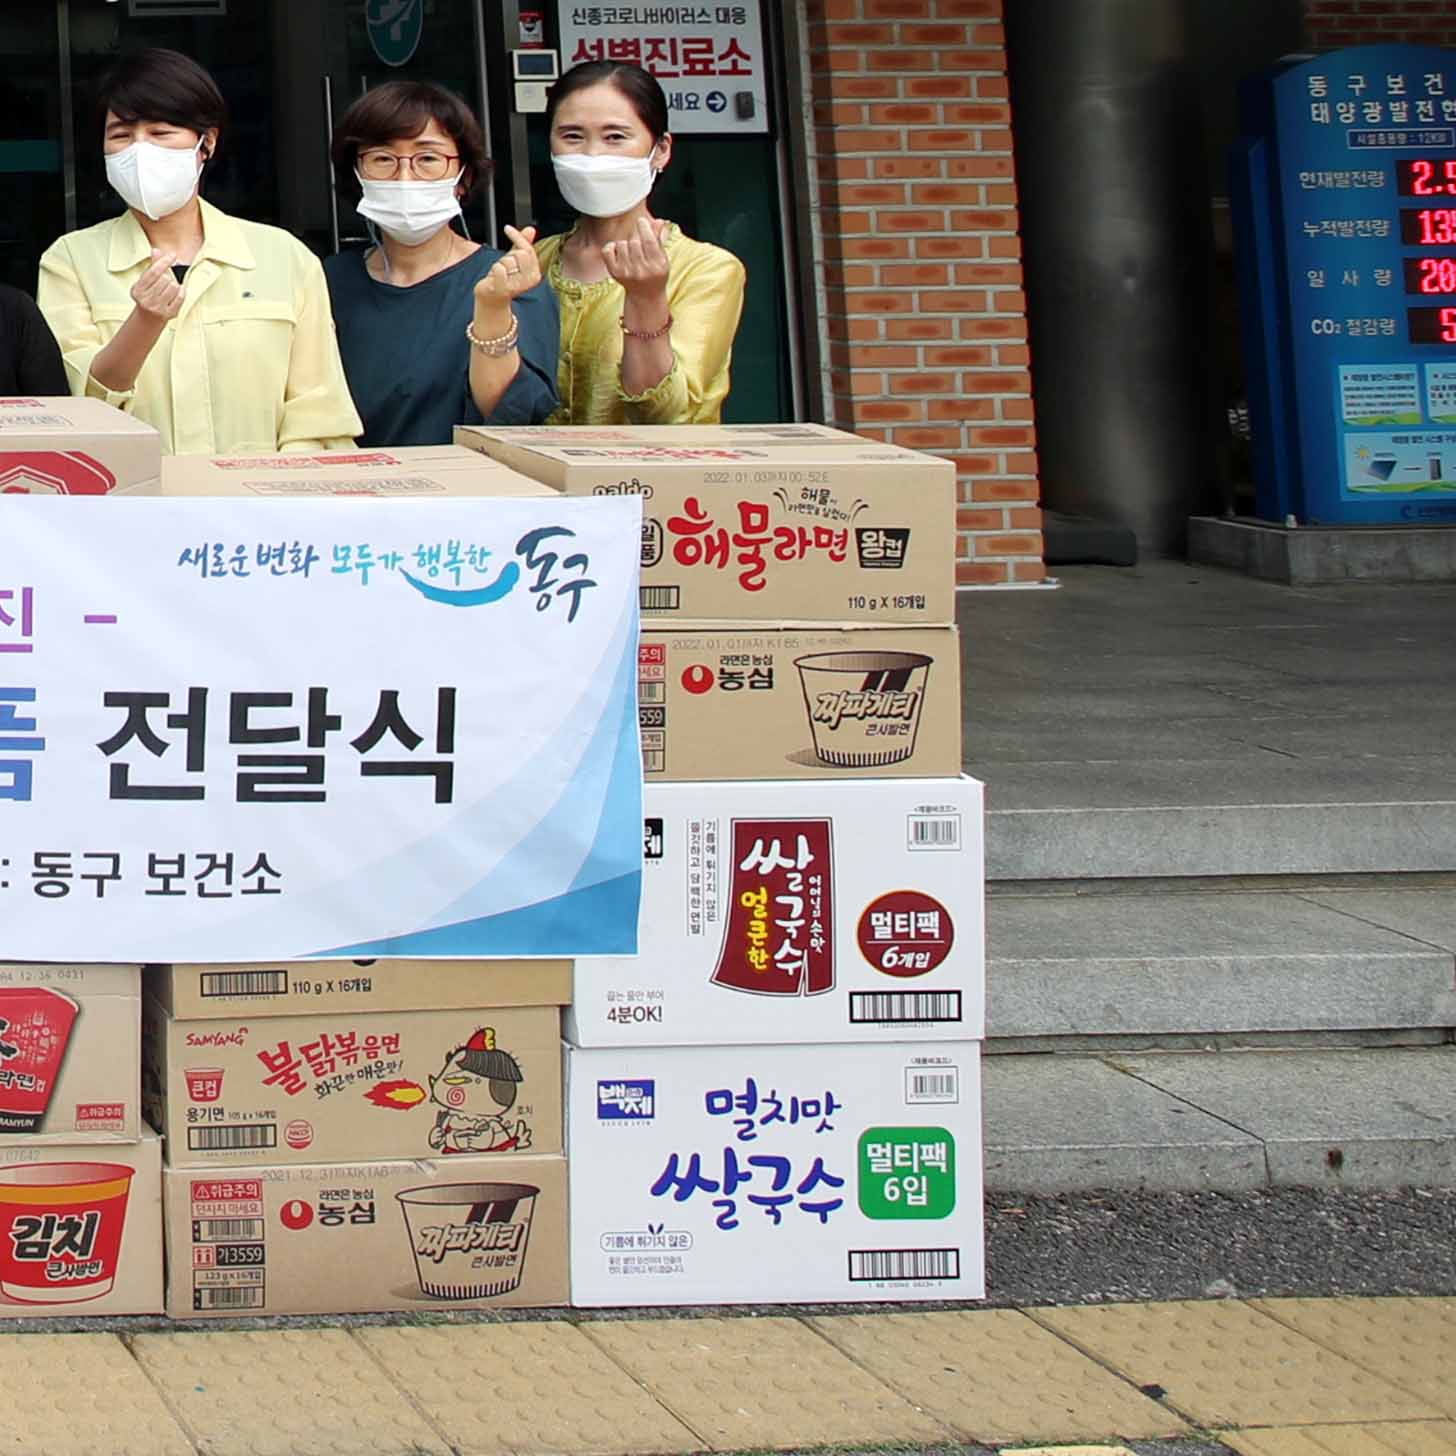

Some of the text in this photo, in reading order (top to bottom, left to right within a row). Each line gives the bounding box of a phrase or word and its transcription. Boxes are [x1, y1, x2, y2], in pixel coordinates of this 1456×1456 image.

[571, 6, 747, 26] 신종코로나바이러스 대응
[666, 496, 850, 592] 해물라면
[177, 525, 599, 624] 새로운 변화 모두가 행복한 동구
[718, 667, 774, 690] 농심
[812, 687, 922, 731] 짜파게티
[95, 684, 458, 804] 전달식
[31, 849, 124, 899] 동구
[144, 849, 284, 899] 보건소
[869, 910, 941, 941] 멀티팩
[291, 980, 312, 995] 110
[337, 976, 372, 993] 16개입
[256, 1030, 401, 1097] 불닭볶음면
[189, 1079, 219, 1099] 큰컵
[704, 1077, 844, 1142] 멸치맛
[865, 1140, 949, 1174] 멀티팩
[650, 1146, 846, 1231] 쌀국수
[882, 1175, 929, 1207] 6입
[9, 1209, 102, 1262] 김치
